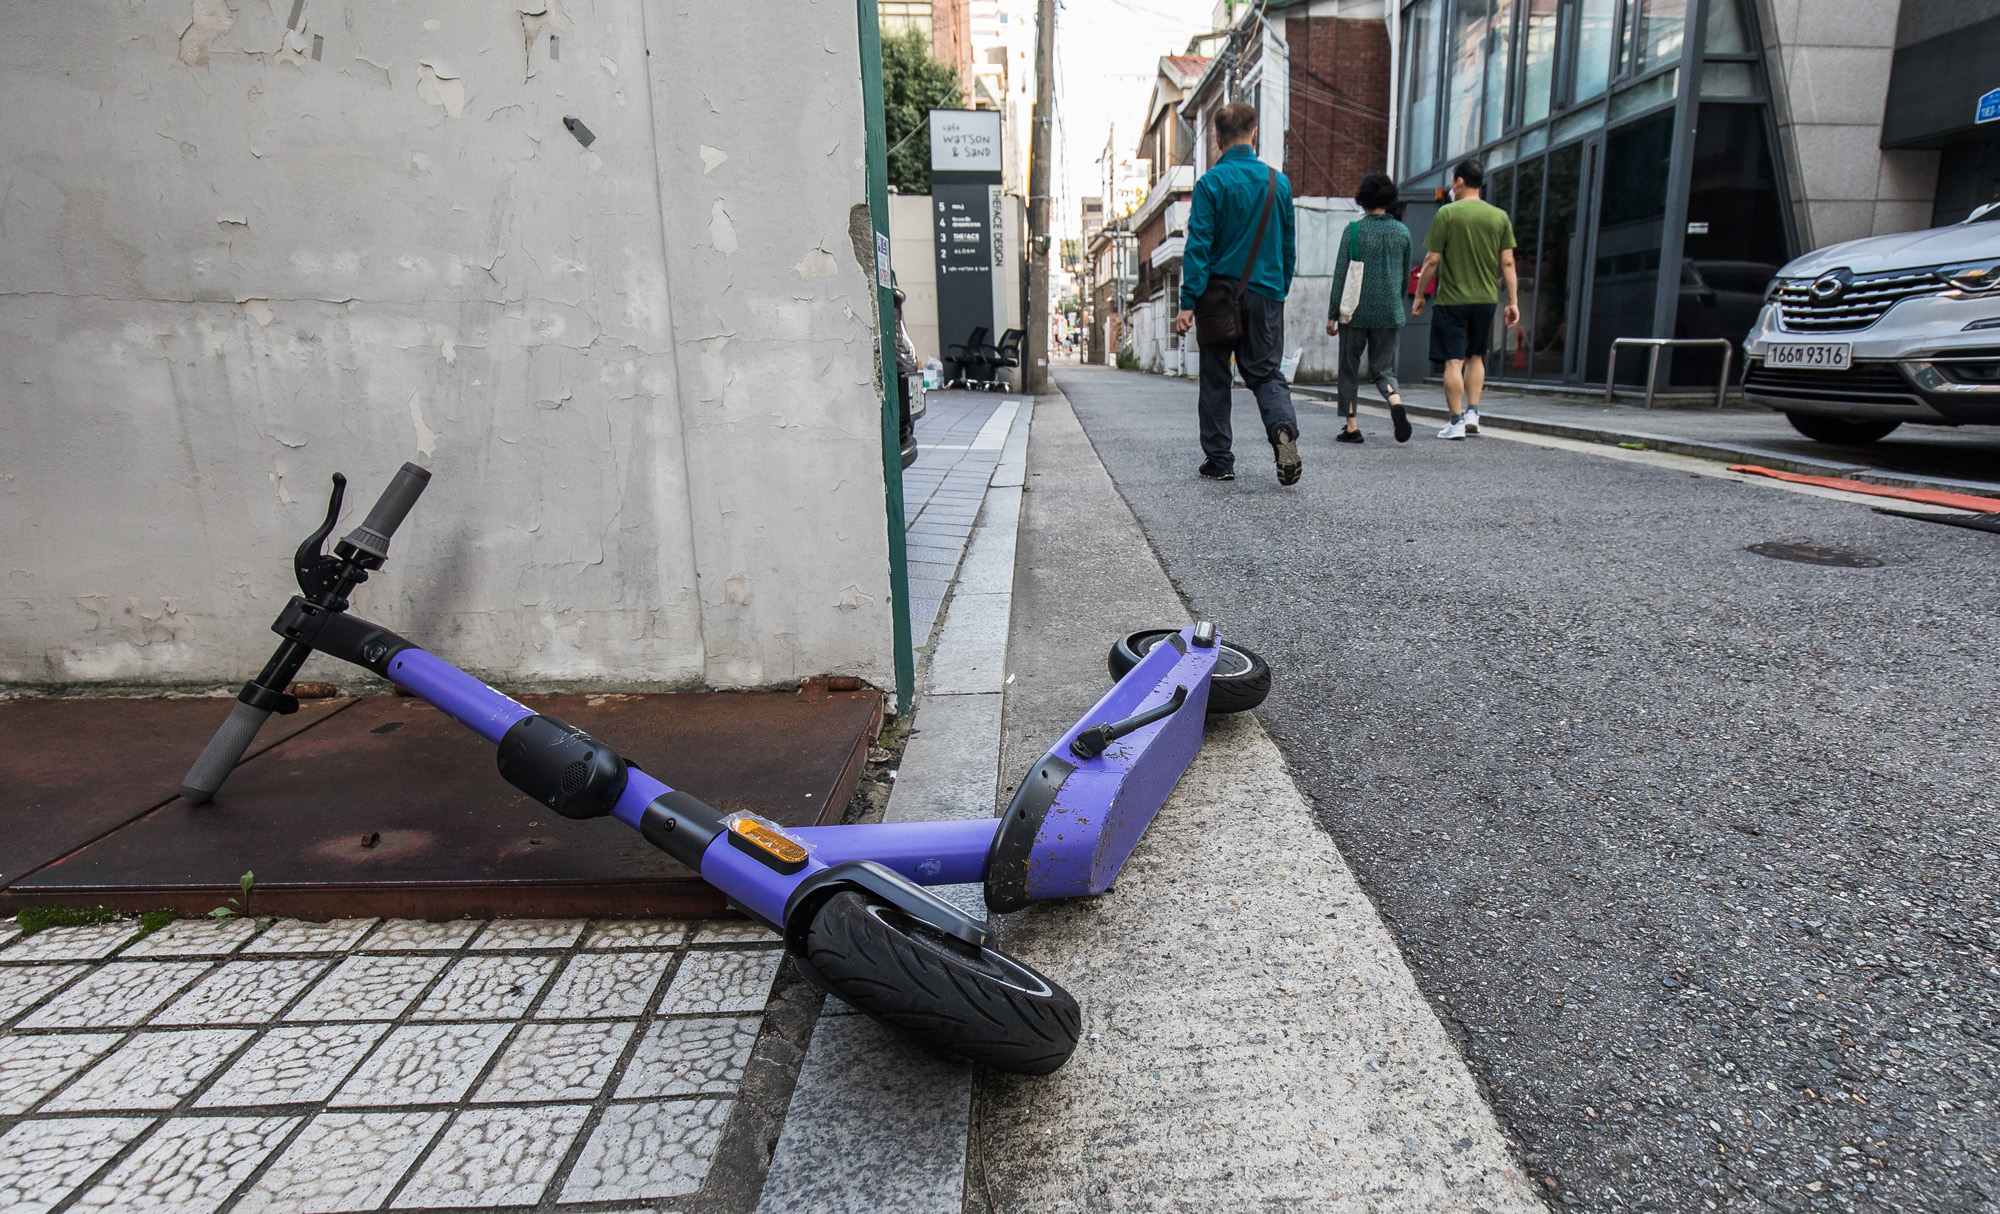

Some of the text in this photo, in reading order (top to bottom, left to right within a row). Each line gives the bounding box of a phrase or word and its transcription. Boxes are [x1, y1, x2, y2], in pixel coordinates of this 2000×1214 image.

[952, 146, 959, 157] &
[938, 202, 946, 212] 5
[939, 218, 946, 227] 4
[940, 233, 947, 243] 3
[940, 249, 947, 259] 2
[993, 232, 1004, 267] DESIGN
[941, 265, 947, 274] 1
[1807, 346, 1843, 364] 9316
